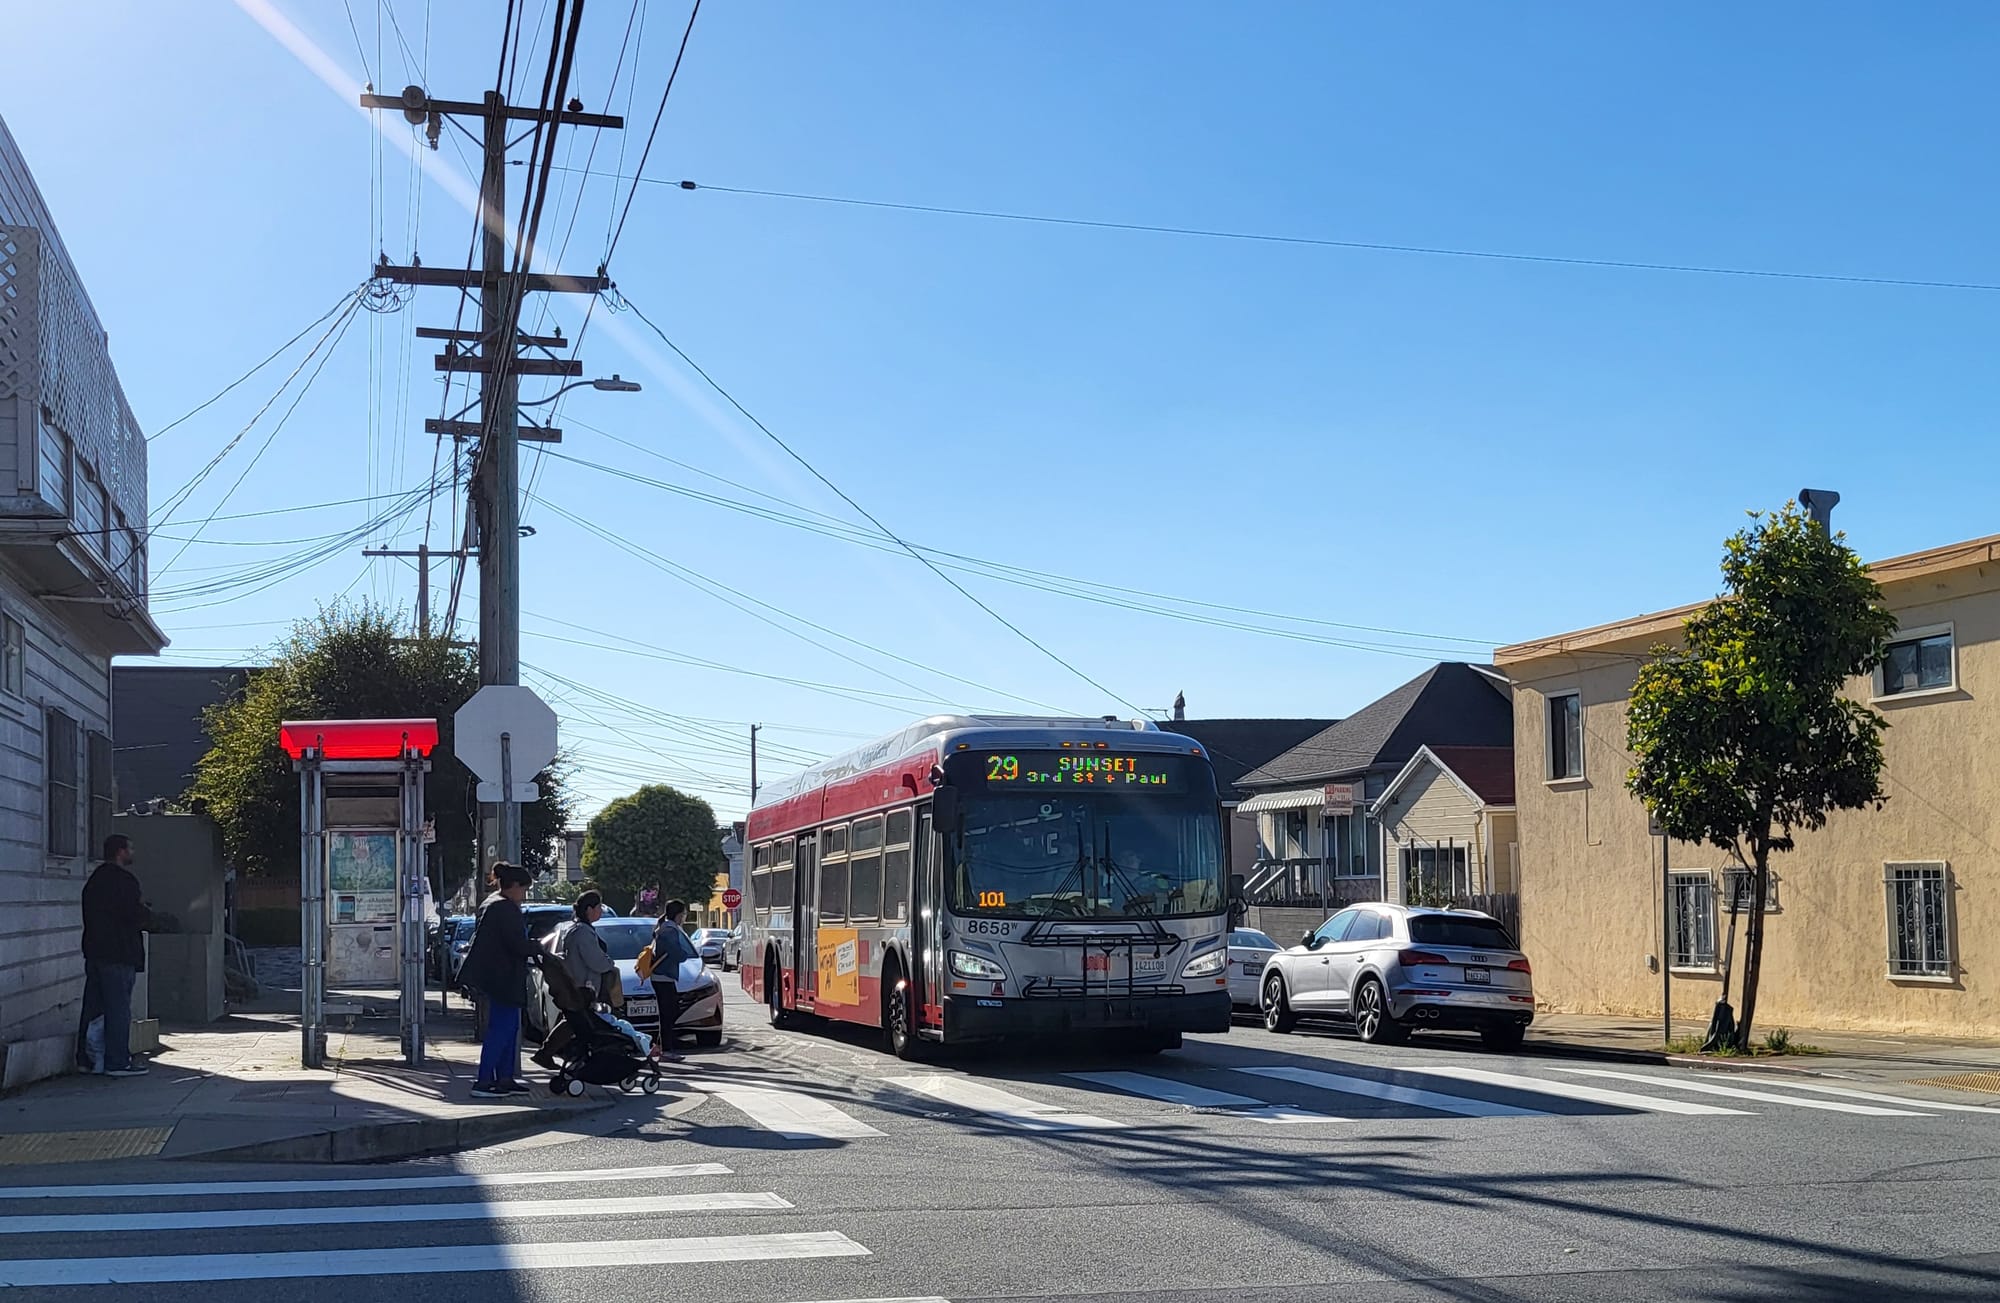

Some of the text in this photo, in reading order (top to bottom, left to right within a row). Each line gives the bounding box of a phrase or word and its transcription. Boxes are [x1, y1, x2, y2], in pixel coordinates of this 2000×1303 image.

[987, 755, 1019, 781] 29
[1059, 757, 1137, 772] SUNSET
[1026, 771, 1168, 784] 3rd St + Paul
[723, 894, 741, 903] STOP
[978, 891, 1006, 907] 101
[968, 920, 1010, 935] 8658
